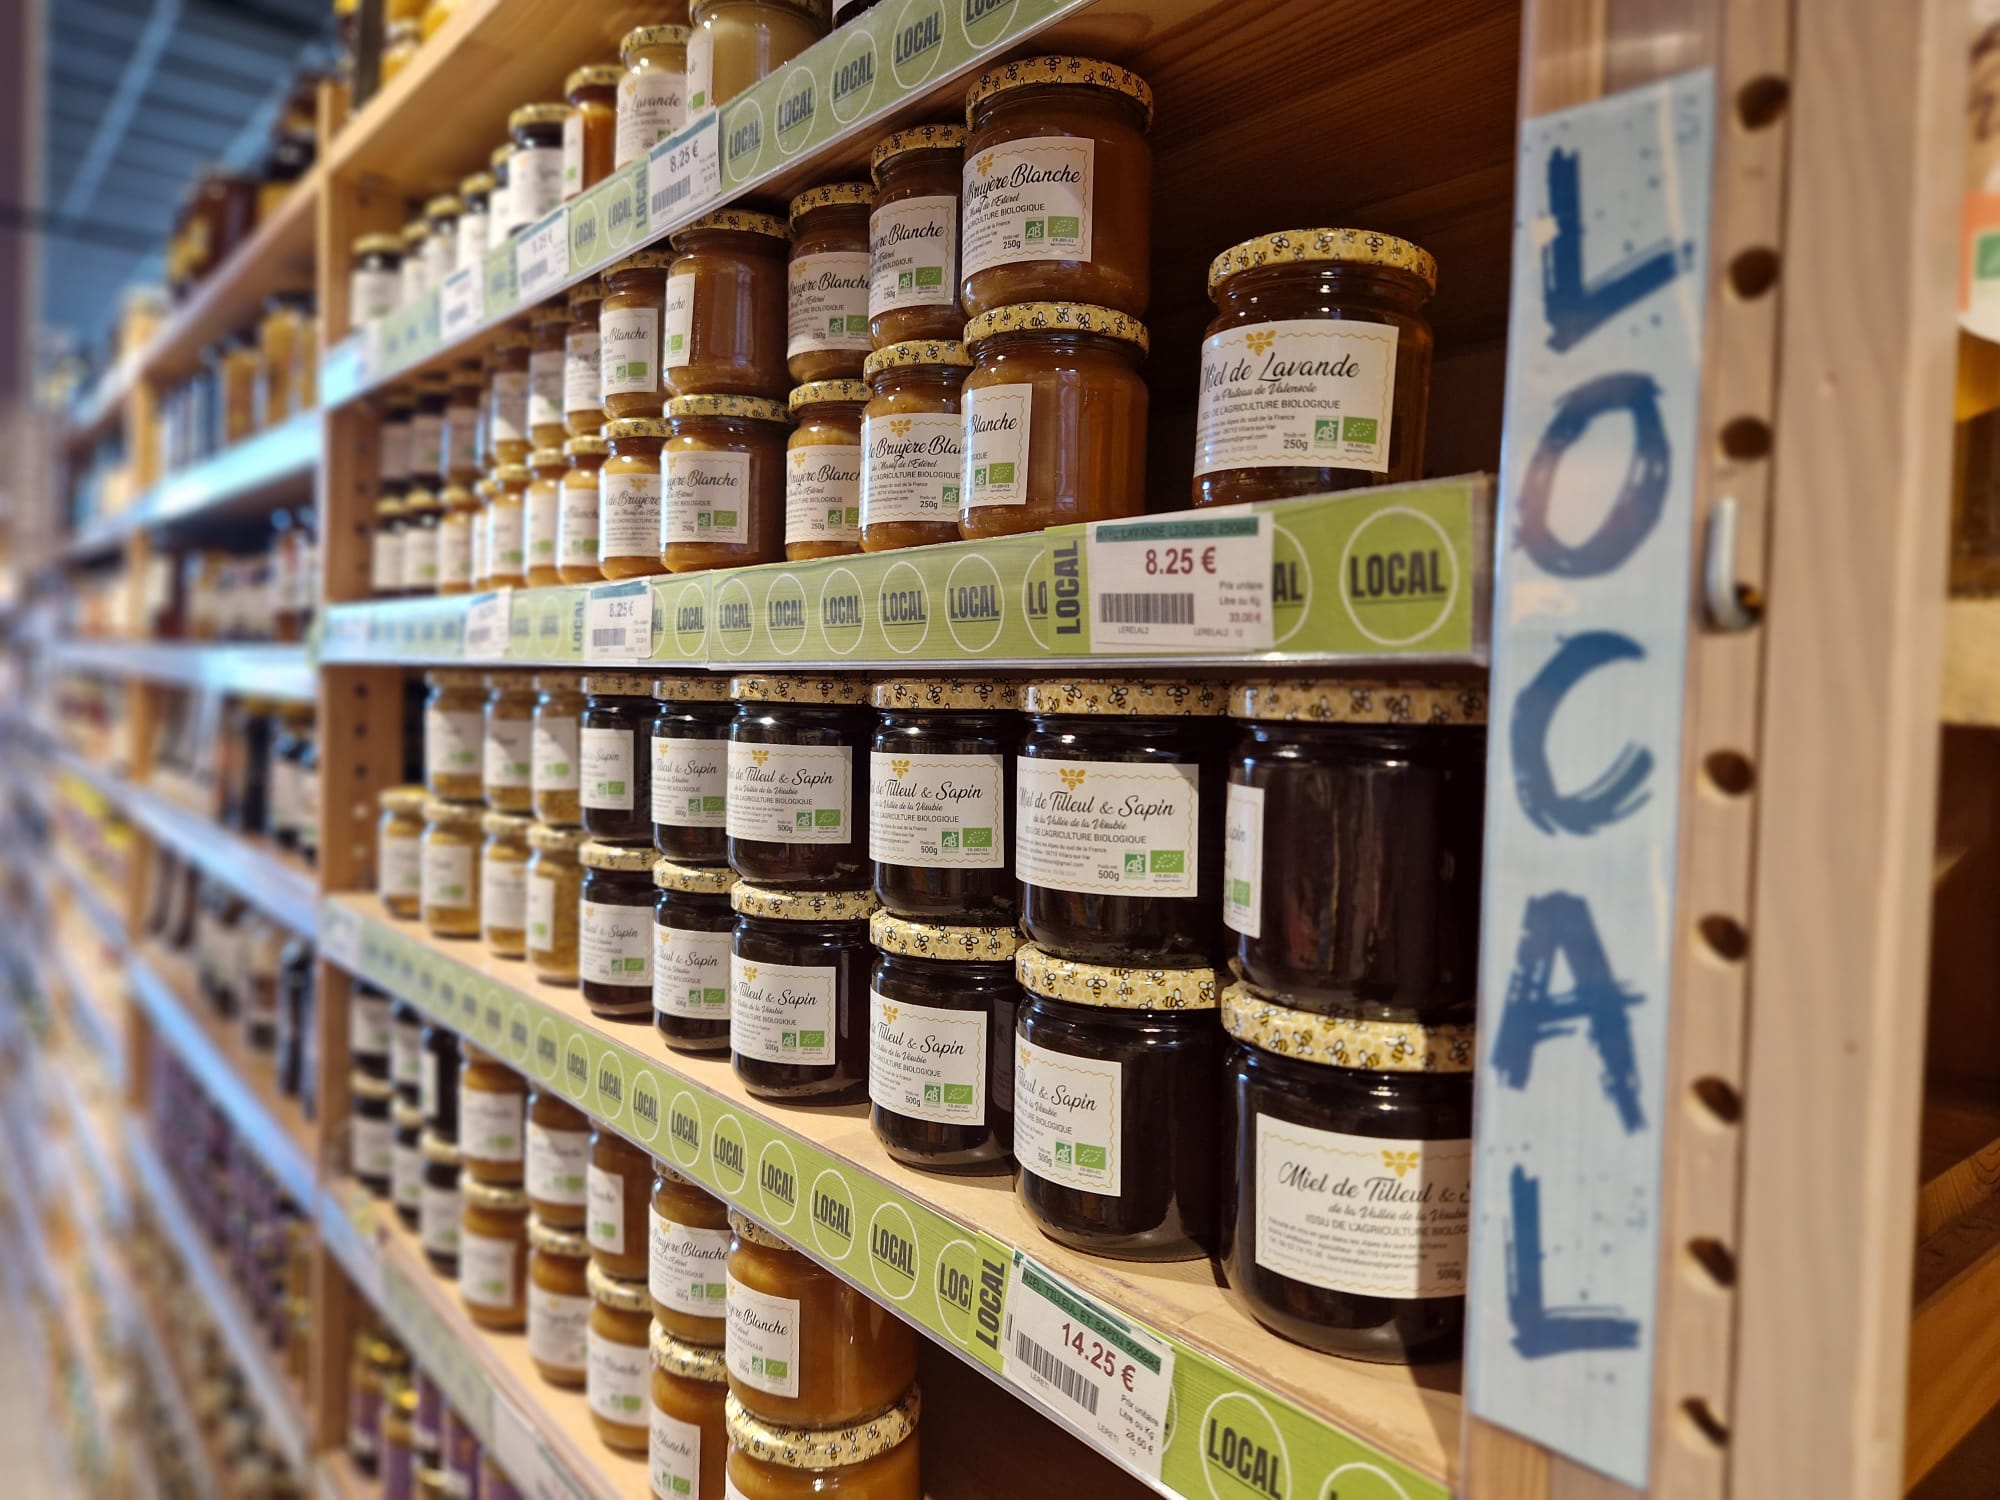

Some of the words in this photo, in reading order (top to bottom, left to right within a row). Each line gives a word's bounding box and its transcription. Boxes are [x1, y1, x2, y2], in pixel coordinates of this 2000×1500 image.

[896, 12, 941, 64] LOCAL
[834, 52, 874, 100] LOCAL
[778, 87, 815, 131] LOCAL
[729, 119, 761, 161] LOCAL
[670, 146, 690, 173] 8.25
[966, 175, 1009, 207] Bruyère
[1009, 163, 1081, 189] Blanche
[608, 198, 633, 229] LOCAL
[1000, 203, 1045, 217] BIOLOGIQUE
[575, 217, 597, 246] LOCAL
[888, 221, 944, 246] Blanche
[1002, 239, 1021, 249] 250g
[1229, 358, 1251, 383] de
[1258, 352, 1361, 383] Lavande
[1281, 400, 1341, 409] BIOLOGIQUE
[968, 412, 1017, 438] Blanche
[875, 437, 927, 462] Bruyère
[928, 434, 961, 456] Bla
[1283, 439, 1308, 451] 250g
[687, 469, 739, 487] Blanche
[917, 471, 961, 480] BIOLOGIQUE
[617, 490, 659, 509] Bruyère
[919, 500, 938, 509] 250g
[1145, 548, 1194, 575] 8.25
[1201, 546, 1216, 574] €
[1351, 551, 1446, 597] LOCAL
[949, 584, 999, 619] LOCAL
[1053, 540, 1081, 635] LOCAL
[609, 602, 628, 618] 8.25
[628, 601, 634, 617] €
[677, 606, 705, 630] LOCAL
[719, 603, 751, 629] LOCAL
[769, 600, 805, 627] LOCAL
[823, 595, 862, 624] LOCAL
[882, 590, 926, 622] LOCAL
[684, 759, 718, 777] Sapin
[1490, 145, 1692, 1366] LOCAL
[745, 767, 776, 783] Tilleul
[778, 775, 789, 784] &
[792, 769, 833, 788] Sapin
[885, 779, 917, 798] Tilleul
[920, 786, 932, 799] &
[935, 780, 983, 804] Sapin
[774, 798, 813, 806] BIOLOGIQUE
[1034, 792, 1047, 810] de
[1049, 790, 1095, 814] Tilleul
[1099, 802, 1114, 815] &
[1118, 795, 1176, 822] Sapin
[777, 824, 793, 833] 500g
[916, 814, 960, 823] BIOLOGIQUE
[920, 845, 938, 856] 500g
[1093, 833, 1147, 844] BIOLOGIQUE
[1098, 870, 1120, 882] 500g
[608, 924, 639, 939] Sapin
[685, 951, 719, 969] Sapin
[765, 992, 775, 1003] &
[777, 988, 818, 1009] Sapin
[762, 1015, 797, 1026] BIOLOGIQUE
[765, 1043, 779, 1053] 500g
[878, 1021, 905, 1046] Tilleul
[906, 1037, 918, 1050] &
[920, 1034, 966, 1059] Sapin
[567, 1051, 588, 1081] LOCAL
[902, 1063, 942, 1078] BIOLOGIQUE
[599, 1069, 622, 1101] LOCAL
[1038, 1085, 1049, 1100] &
[1050, 1084, 1098, 1112] Sapin
[633, 1087, 658, 1122] LOCAL
[905, 1095, 921, 1107] 500g
[671, 1109, 699, 1147] LOCAL
[1035, 1116, 1073, 1135] BIOLOGIQUE
[714, 1133, 744, 1173] LOCAL
[1038, 1152, 1053, 1168] 500g
[761, 1159, 795, 1204] LOCAL
[1279, 1161, 1327, 1194] Miel
[1331, 1179, 1360, 1199] de
[1364, 1176, 1433, 1204] Tilleul
[1438, 1188, 1456, 1203] &
[813, 1189, 851, 1238] LOCAL
[1305, 1214, 1330, 1228] ISSU
[1331, 1218, 1346, 1229] DE
[1348, 1221, 1431, 1237] L'AGRICULTURE
[872, 1223, 915, 1277] LOCAL
[939, 1263, 973, 1310] LOC
[975, 1258, 1005, 1351] LOCAL
[1022, 1270, 1042, 1292] MIEL
[1044, 1286, 1078, 1316] TILLEUL
[1080, 1310, 1091, 1324] ET
[1095, 1321, 1125, 1346] SAPIN
[743, 1308, 789, 1336] Blanche
[1062, 1322, 1116, 1377] 14.25
[1121, 1364, 1136, 1392] €
[1120, 1394, 1134, 1408] Prix
[1135, 1406, 1159, 1427] unitaire
[1208, 1417, 1282, 1499] LOCAL
